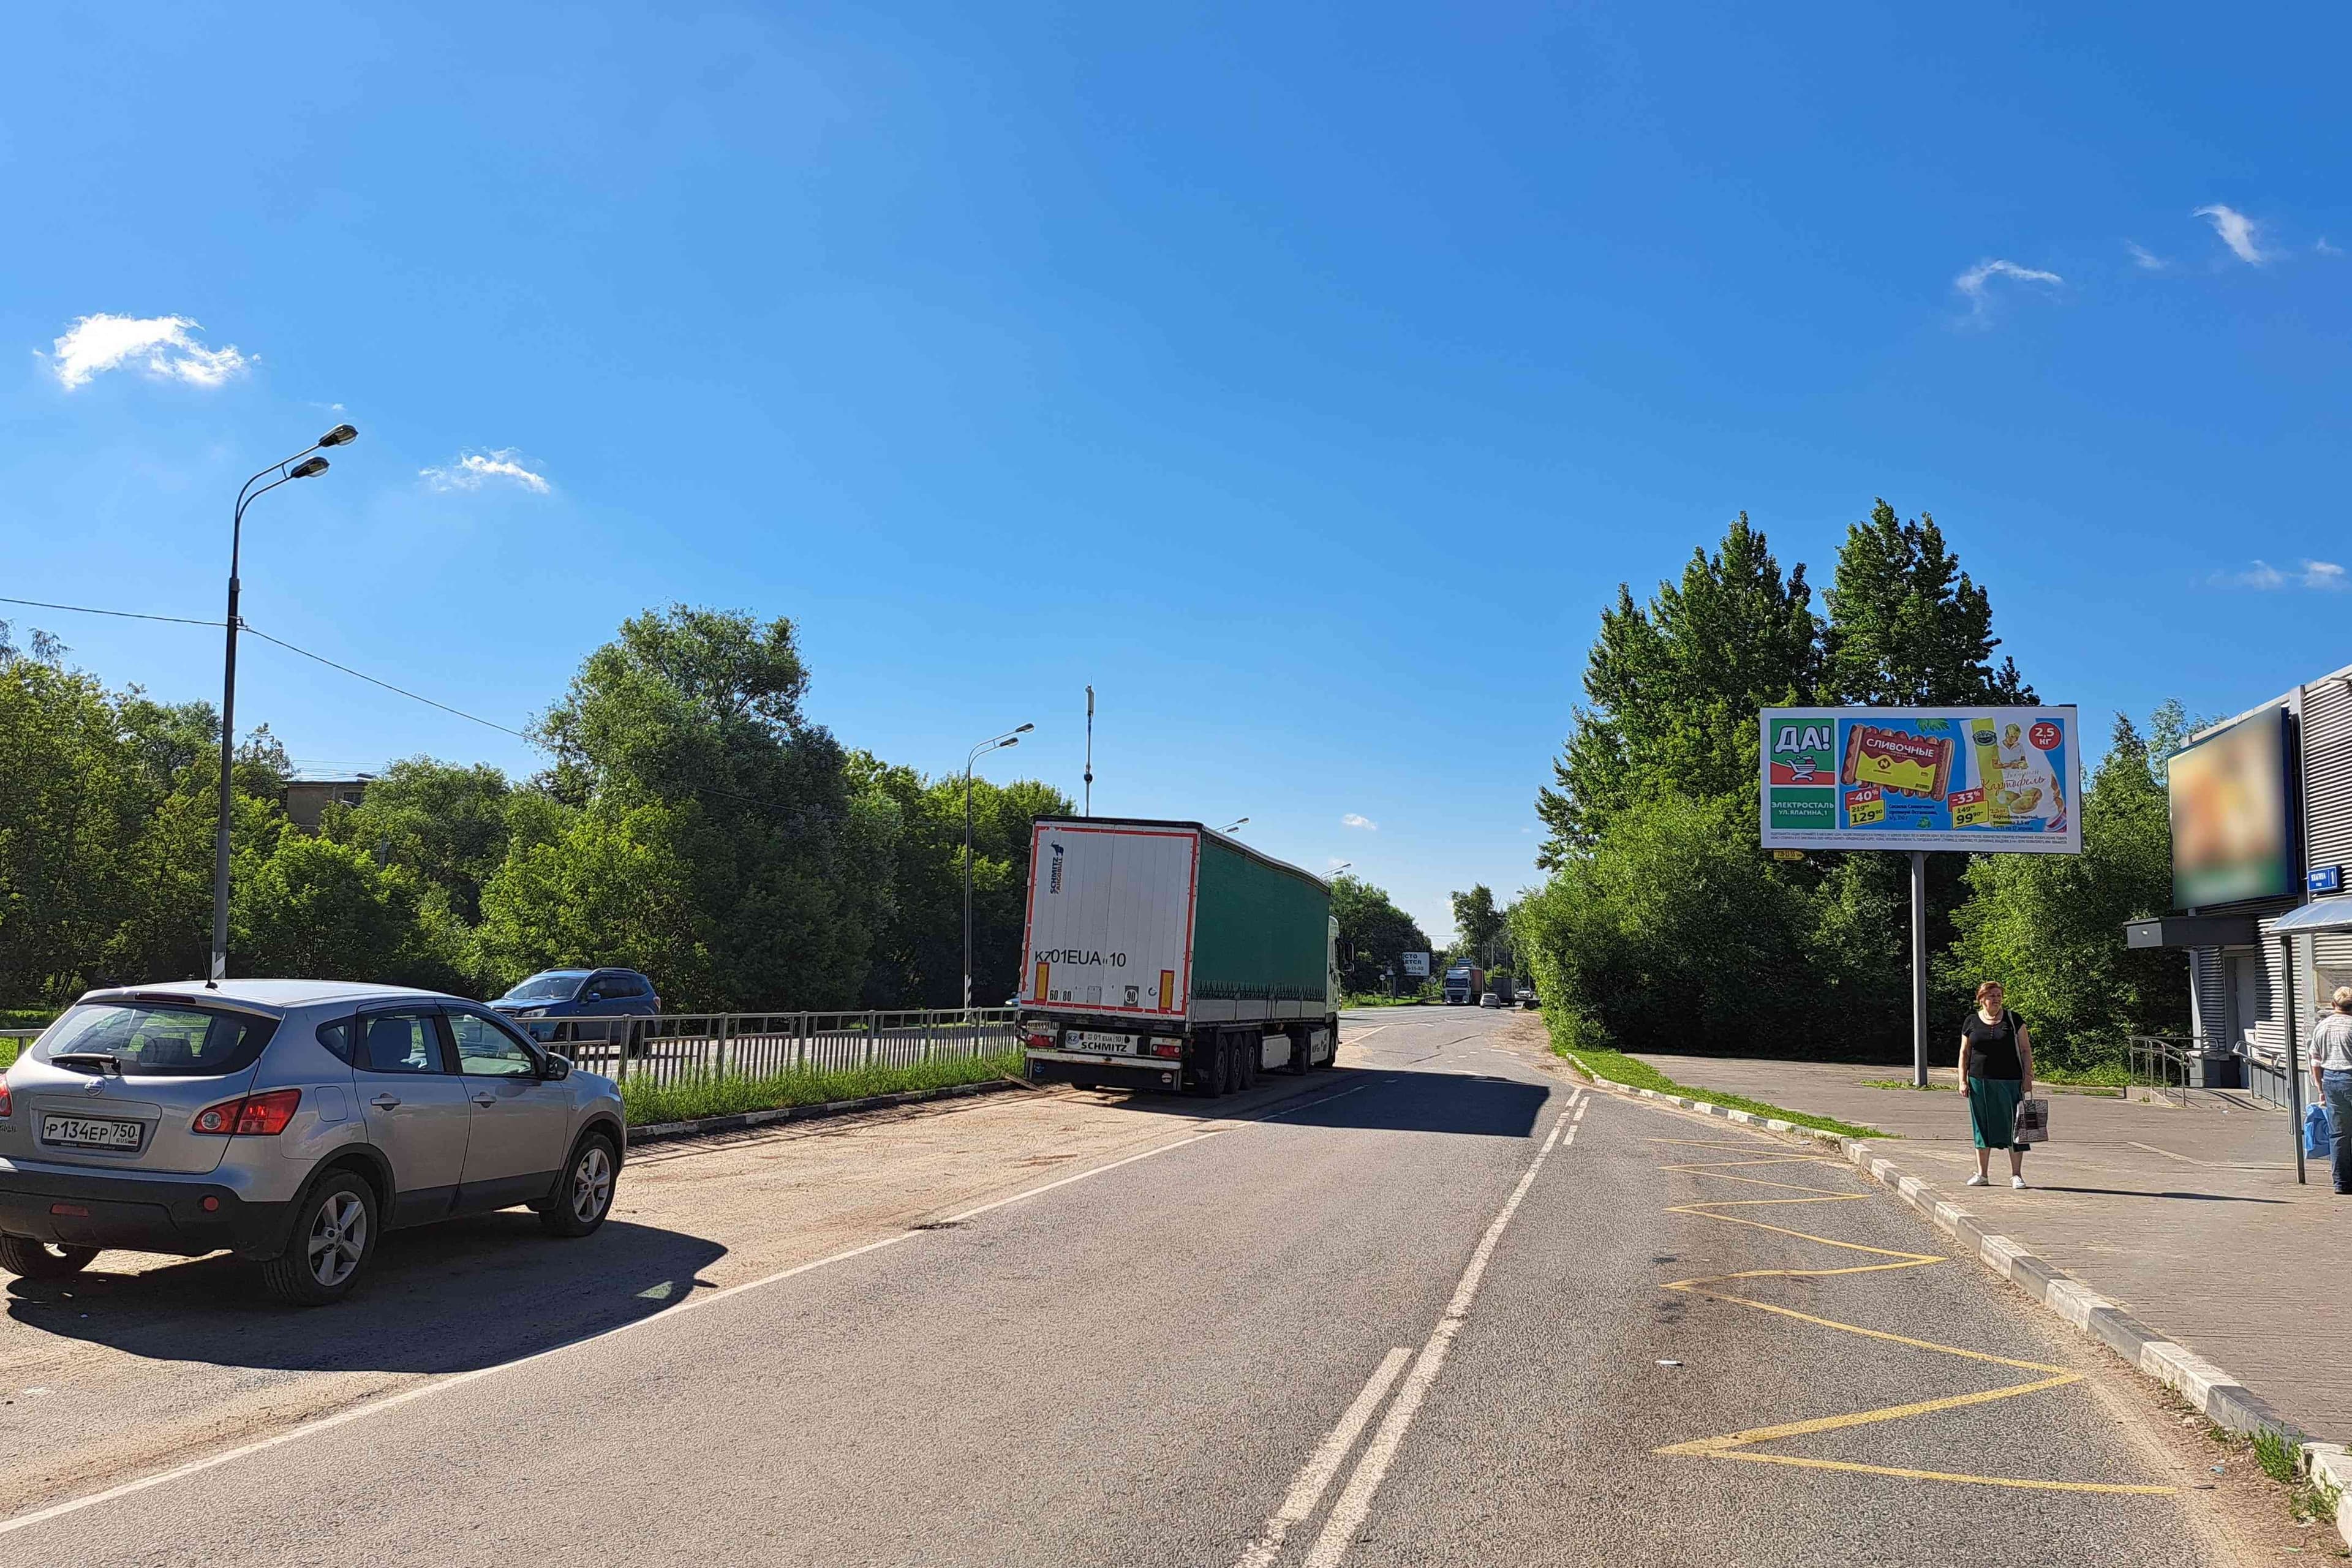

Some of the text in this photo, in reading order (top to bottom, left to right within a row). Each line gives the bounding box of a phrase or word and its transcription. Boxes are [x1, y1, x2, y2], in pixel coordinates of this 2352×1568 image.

[2035, 728, 2054, 738] 2,5
[1774, 726, 1831, 754] ДА!
[1866, 738, 1935, 758] СЛИВОЧНЫЕ
[1849, 789, 1879, 802] -40%
[1952, 791, 1981, 804] -33%
[1050, 857, 1059, 894] SCHMITZ
[1110, 952, 1126, 967] 10
[1049, 989, 1058, 1001] 60
[1063, 990, 1072, 1001] 80
[1126, 990, 1136, 1002] 90
[1081, 1041, 1127, 1052] SCHMITZ
[112, 1124, 136, 1138] 750
